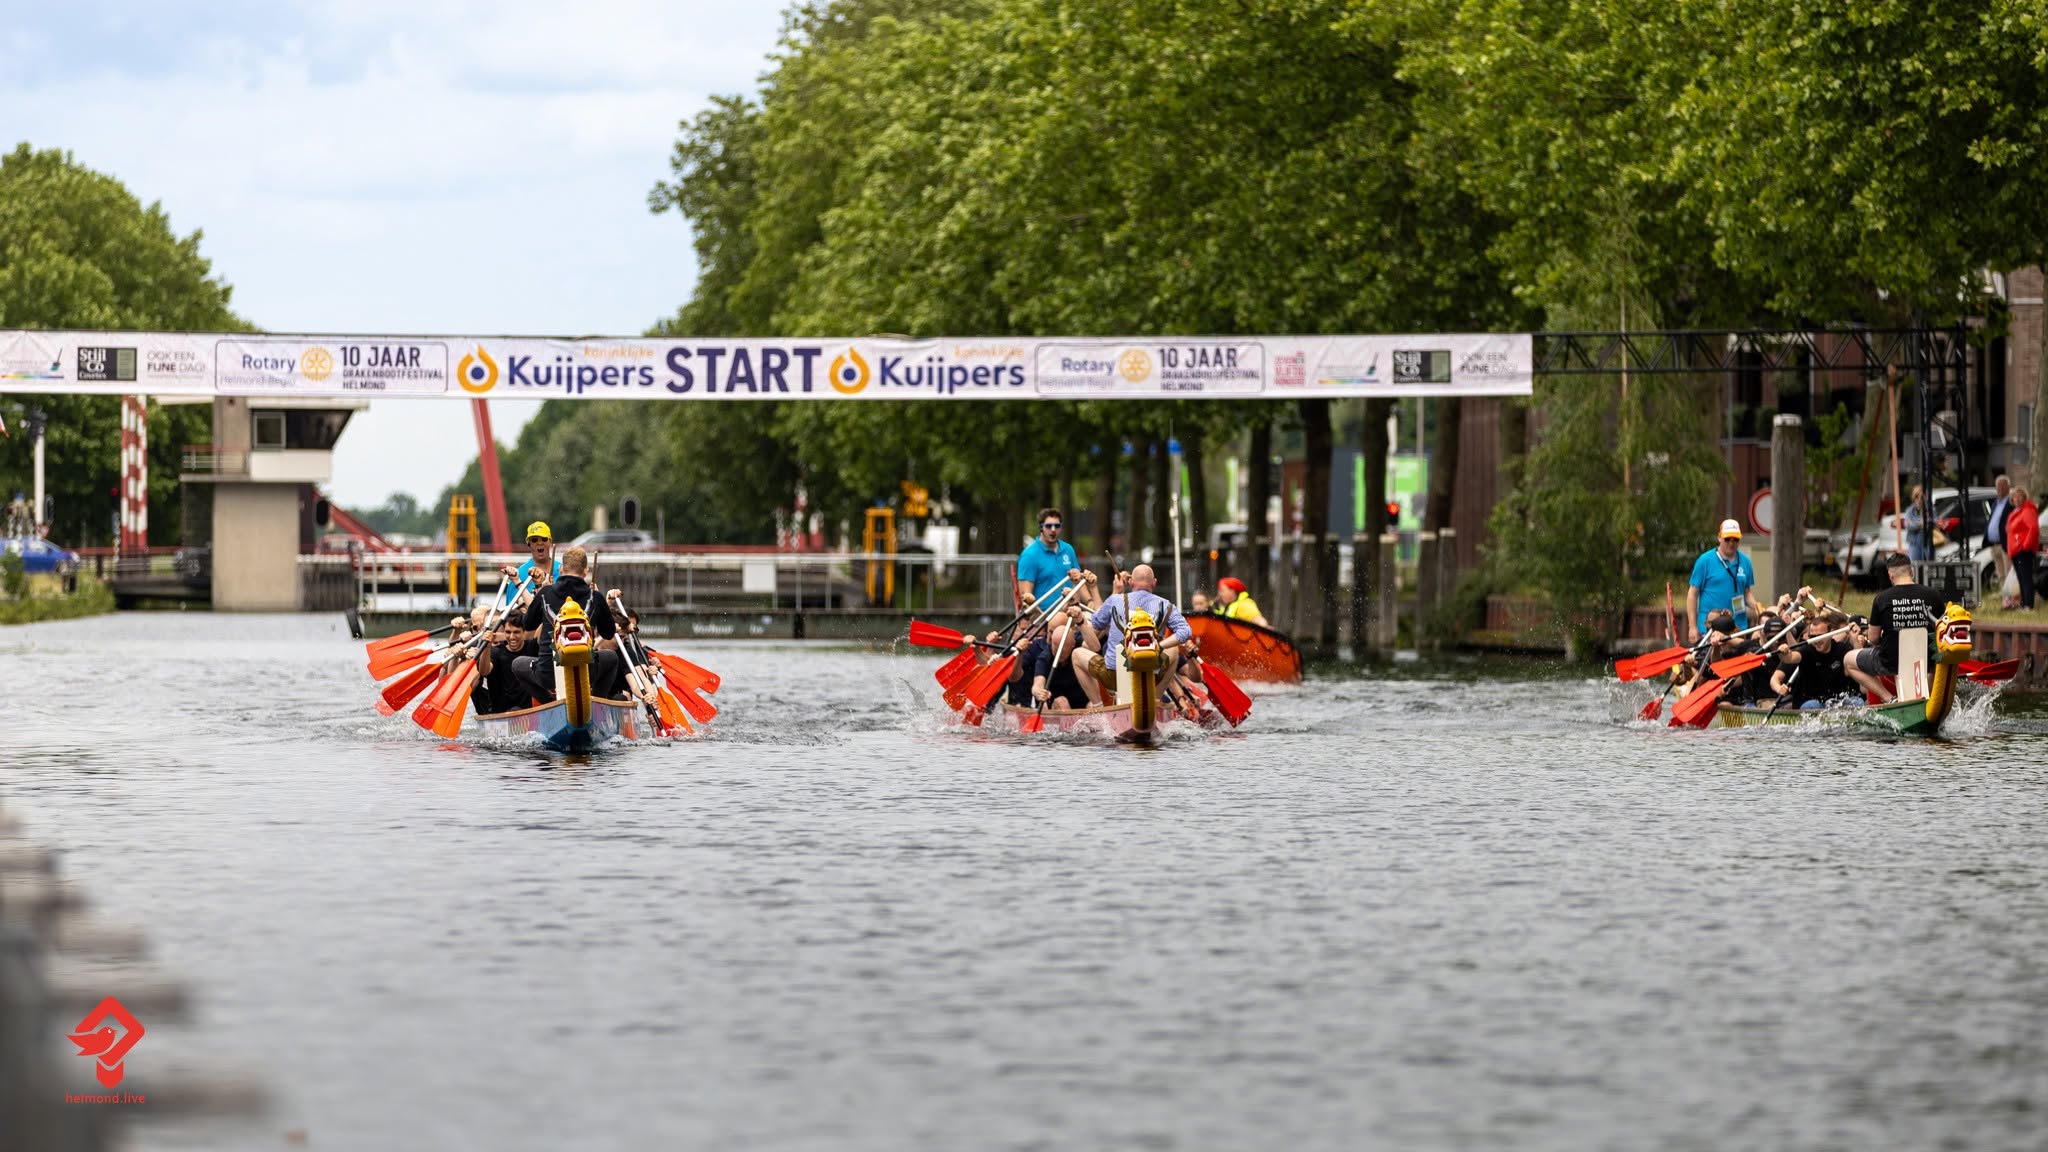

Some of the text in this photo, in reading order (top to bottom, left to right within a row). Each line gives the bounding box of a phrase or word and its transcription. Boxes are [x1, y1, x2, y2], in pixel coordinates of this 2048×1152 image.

[175, 351, 195, 361] EEN
[241, 354, 296, 373] Rotary
[341, 346, 420, 367] 10 JAAR
[1159, 348, 1237, 368] 10 JAAR
[508, 355, 655, 394] Kuijpers
[666, 347, 822, 393] START
[879, 356, 1025, 394] Kuijpers
[1061, 357, 1115, 376] Rotary
[343, 381, 386, 390] HELMOND
[1892, 598, 1910, 606] Built
[1915, 666, 1920, 694] 3
